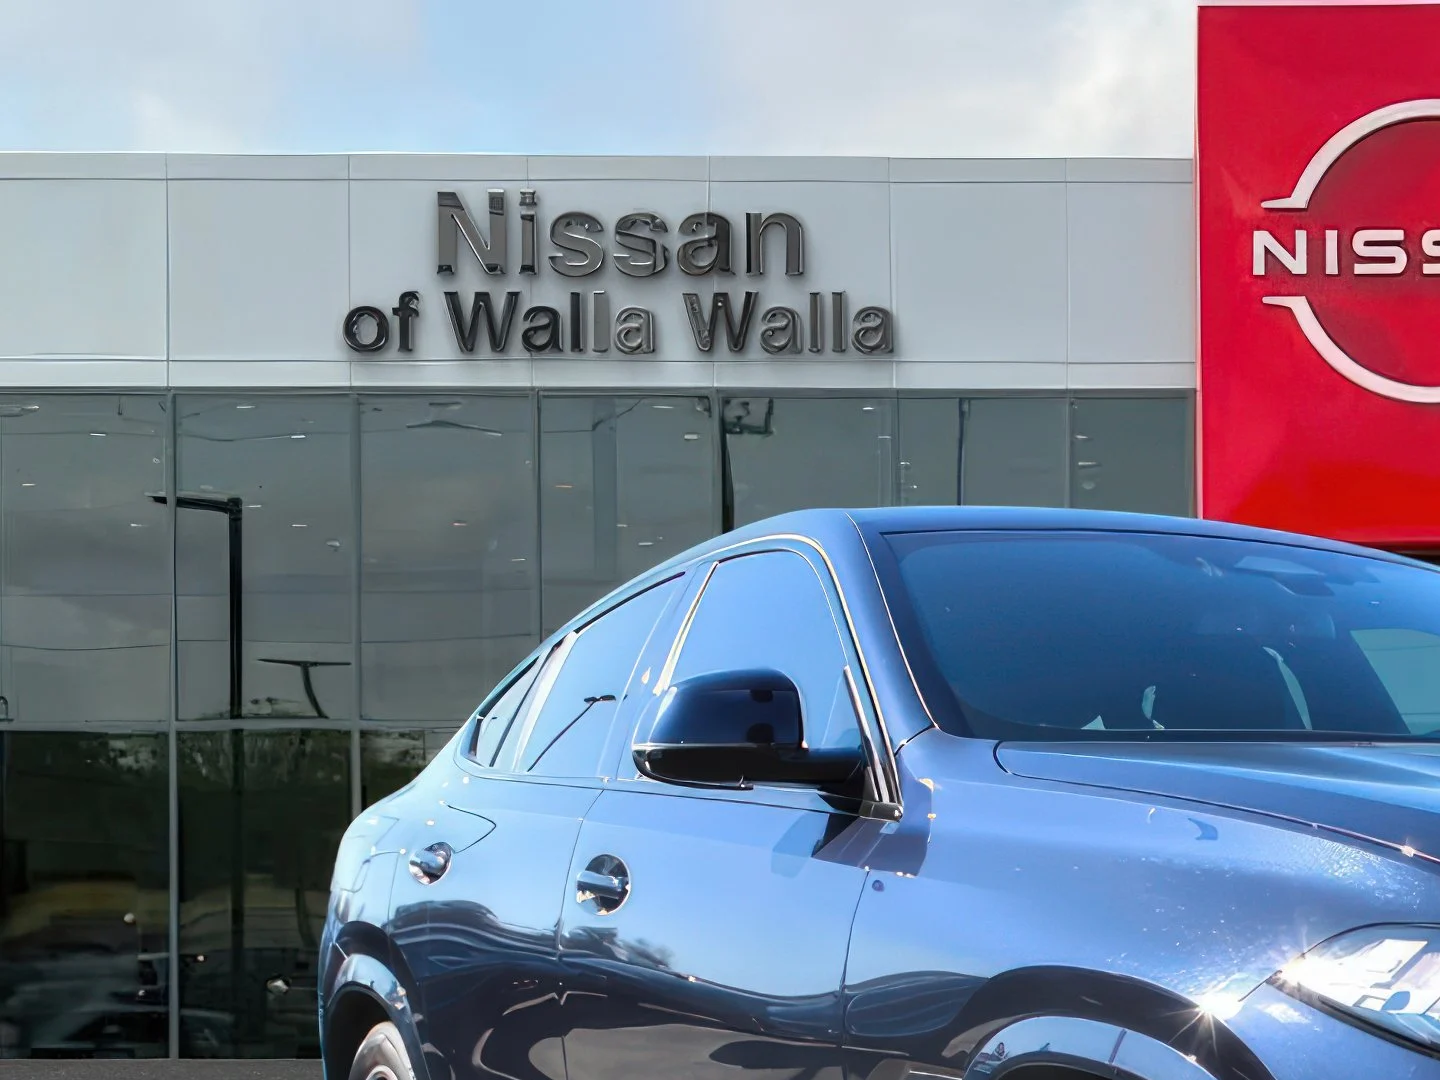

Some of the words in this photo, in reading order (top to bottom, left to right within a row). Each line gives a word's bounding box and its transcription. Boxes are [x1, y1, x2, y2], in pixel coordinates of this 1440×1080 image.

[436, 188, 805, 277] Nissan
[342, 290, 421, 354] of
[443, 290, 655, 354] Walla
[682, 290, 894, 354] Walla
